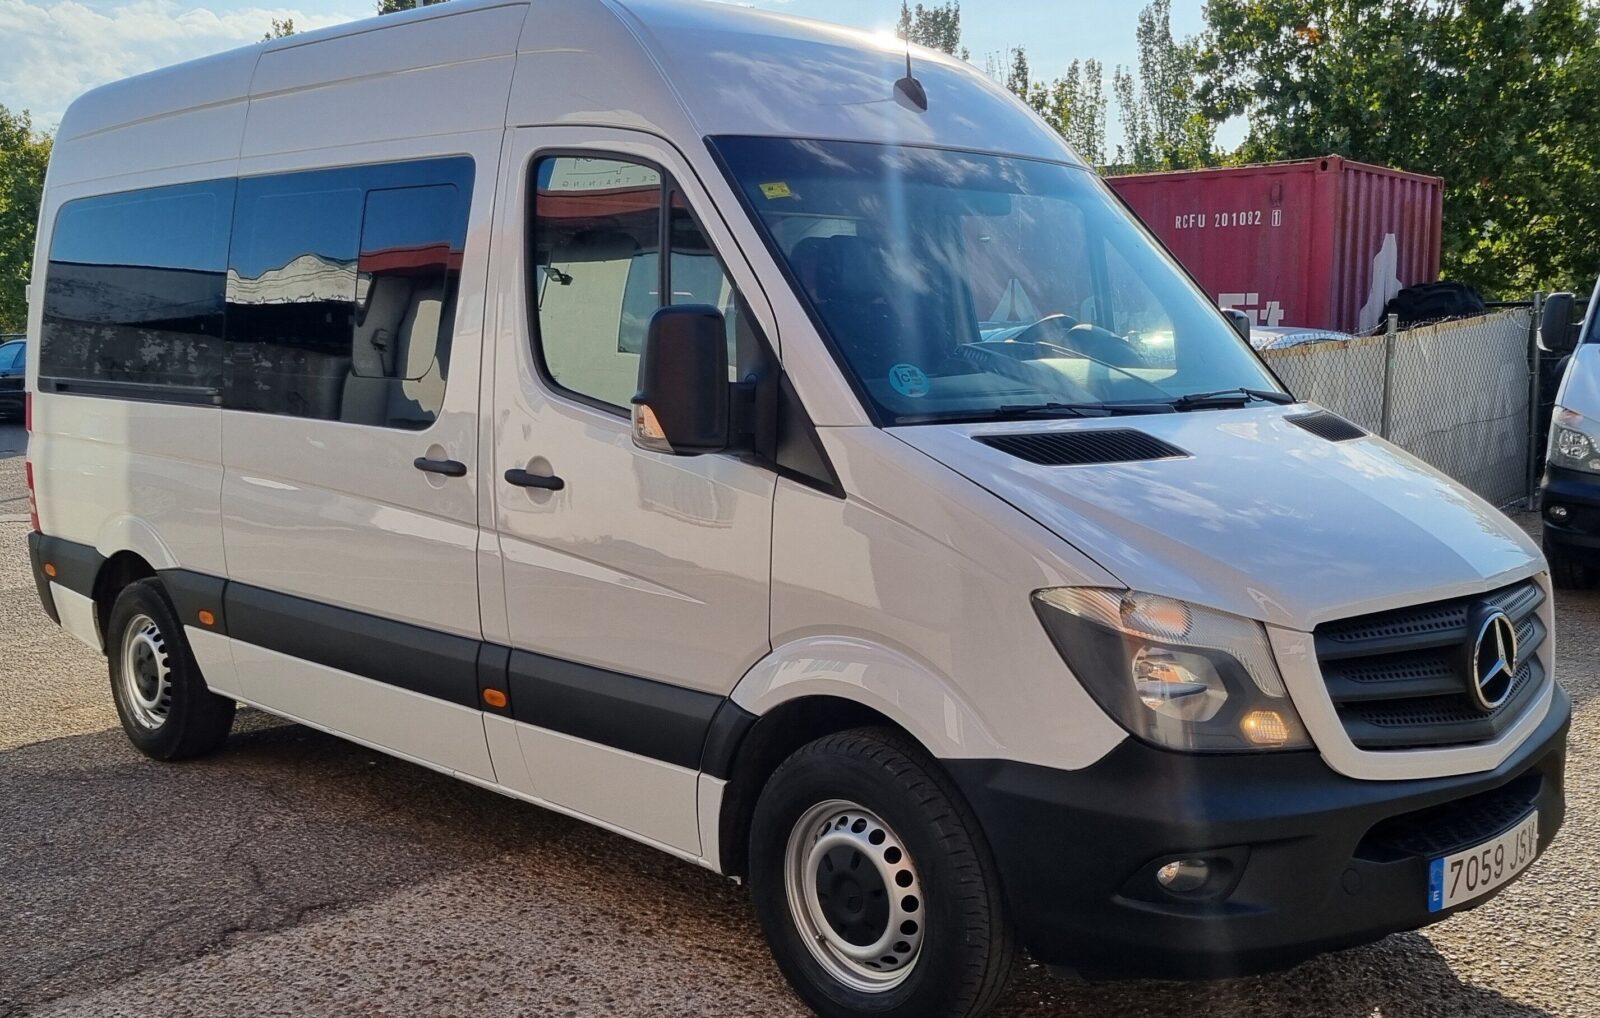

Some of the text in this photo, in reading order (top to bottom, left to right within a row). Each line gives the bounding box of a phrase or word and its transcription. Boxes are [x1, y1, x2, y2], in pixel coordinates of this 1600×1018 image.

[1175, 214, 1206, 229] RCFU
[1214, 210, 1261, 228] 201082
[1449, 820, 1536, 899] 7059 JSV
[1432, 890, 1440, 902] E
